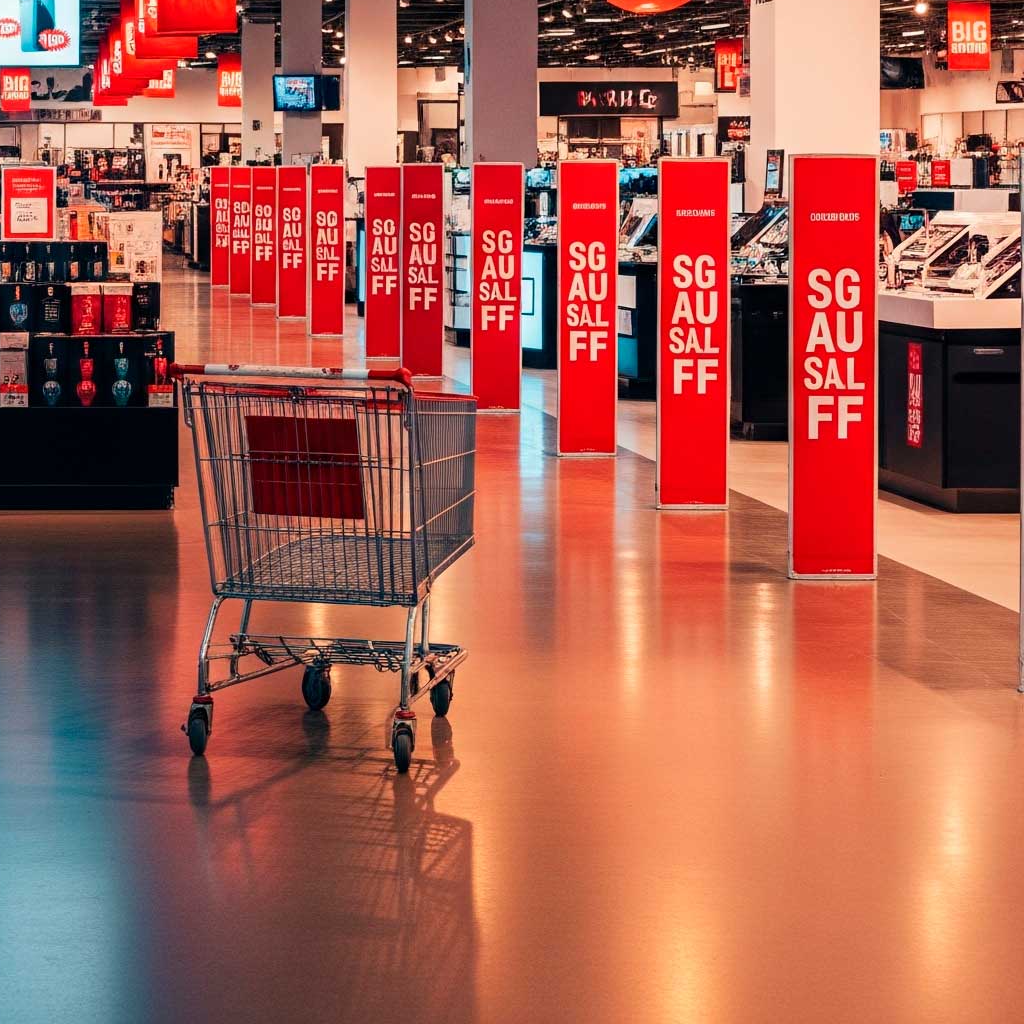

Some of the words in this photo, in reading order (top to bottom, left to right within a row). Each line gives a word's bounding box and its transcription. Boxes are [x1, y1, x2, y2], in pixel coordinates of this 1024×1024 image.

[952, 21, 987, 43] BIG
[283, 223, 302, 238] AU
[317, 228, 338, 245] AU
[410, 222, 435, 242] SG
[482, 230, 512, 253] SG
[256, 246, 272, 261] FF
[372, 237, 397, 255] AU
[409, 244, 436, 265] AU
[569, 241, 606, 271] SG
[283, 253, 302, 269] FF
[317, 263, 339, 281] FF
[481, 255, 514, 280] AU
[673, 255, 715, 289] SG
[372, 275, 397, 295] FF
[408, 266, 438, 284] SAL
[568, 272, 608, 301] AU
[410, 287, 437, 310] FF
[479, 281, 517, 301] SAL
[808, 268, 860, 309] SG
[567, 304, 609, 327] SAL
[672, 288, 718, 324] AU
[481, 305, 514, 331] FF
[669, 327, 720, 354] SAL
[806, 311, 863, 353] AU
[570, 331, 608, 361] FF
[674, 359, 718, 394] FF
[804, 357, 865, 390] SAL
[808, 396, 863, 439] FF
